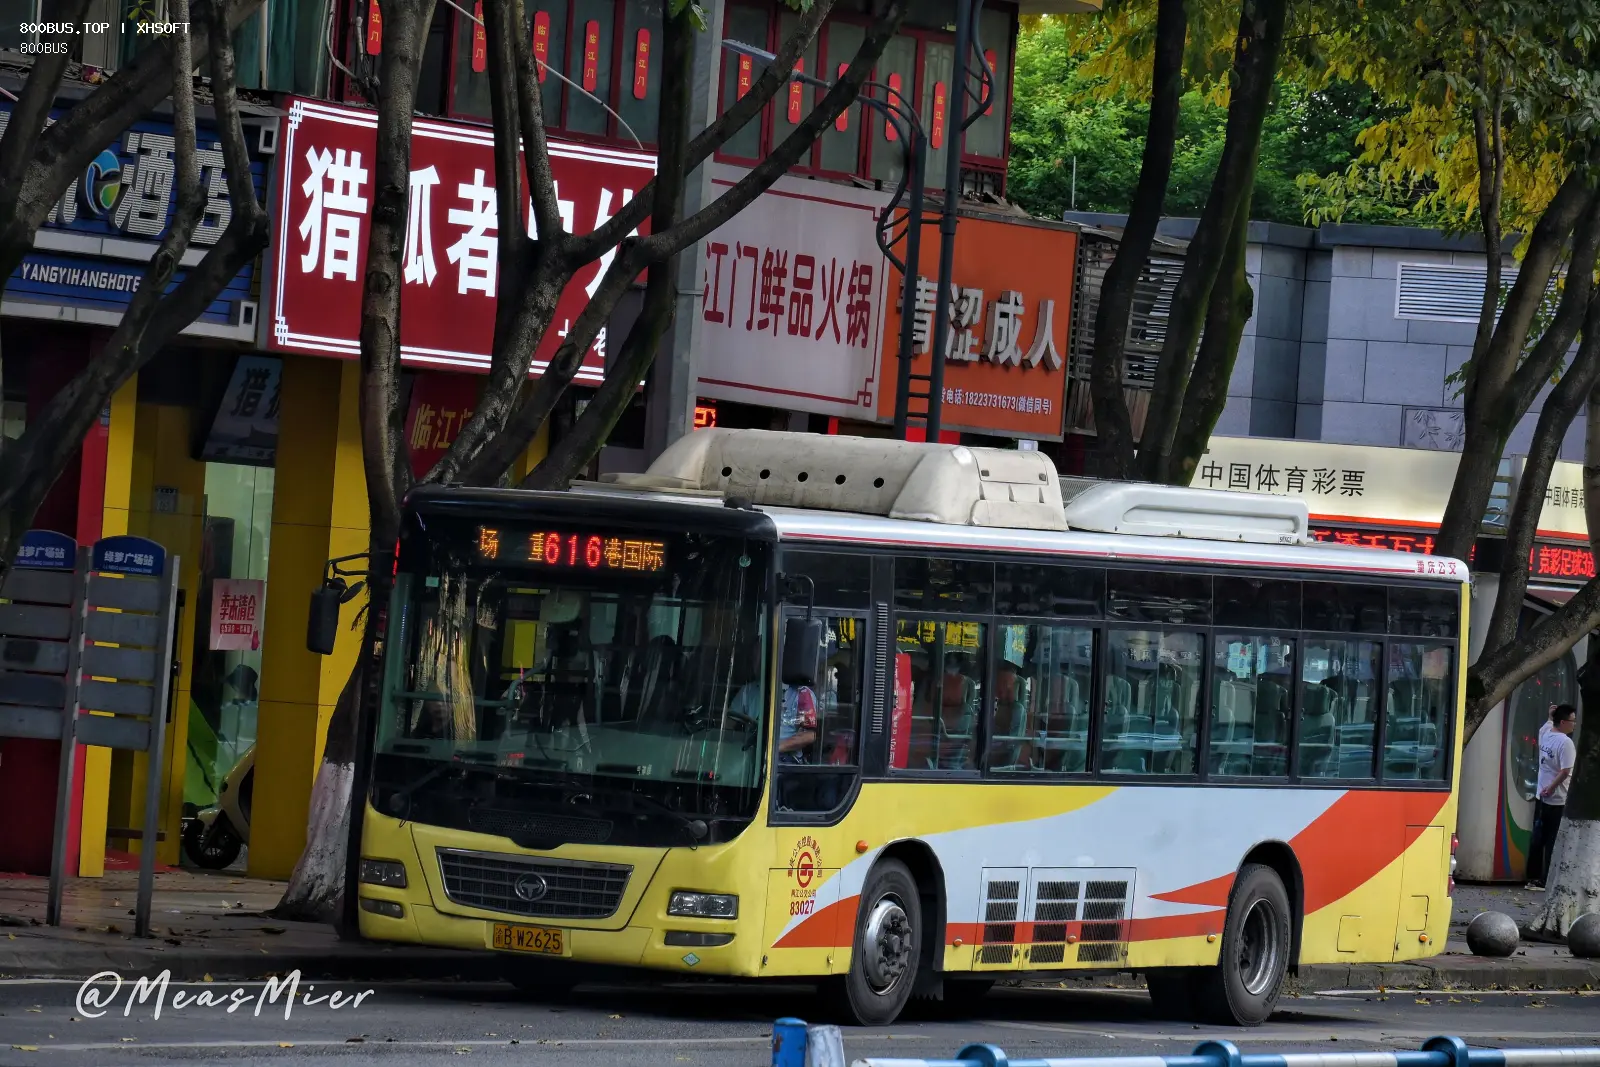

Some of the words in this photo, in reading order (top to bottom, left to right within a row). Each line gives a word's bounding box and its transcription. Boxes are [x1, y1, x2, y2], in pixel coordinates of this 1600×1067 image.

[370, 0, 381, 42] 江门
[587, 34, 597, 79] 临江门
[637, 42, 648, 86] 临江门
[740, 59, 751, 98] 临江
[792, 69, 802, 110] 江门
[1200, 461, 1366, 497] 中国体育彩票
[480, 528, 500, 559] 场
[545, 532, 602, 568] 616
[604, 538, 665, 572] 港国际
[1417, 560, 1457, 575] 重庆公交
[790, 900, 815, 916] 83027
